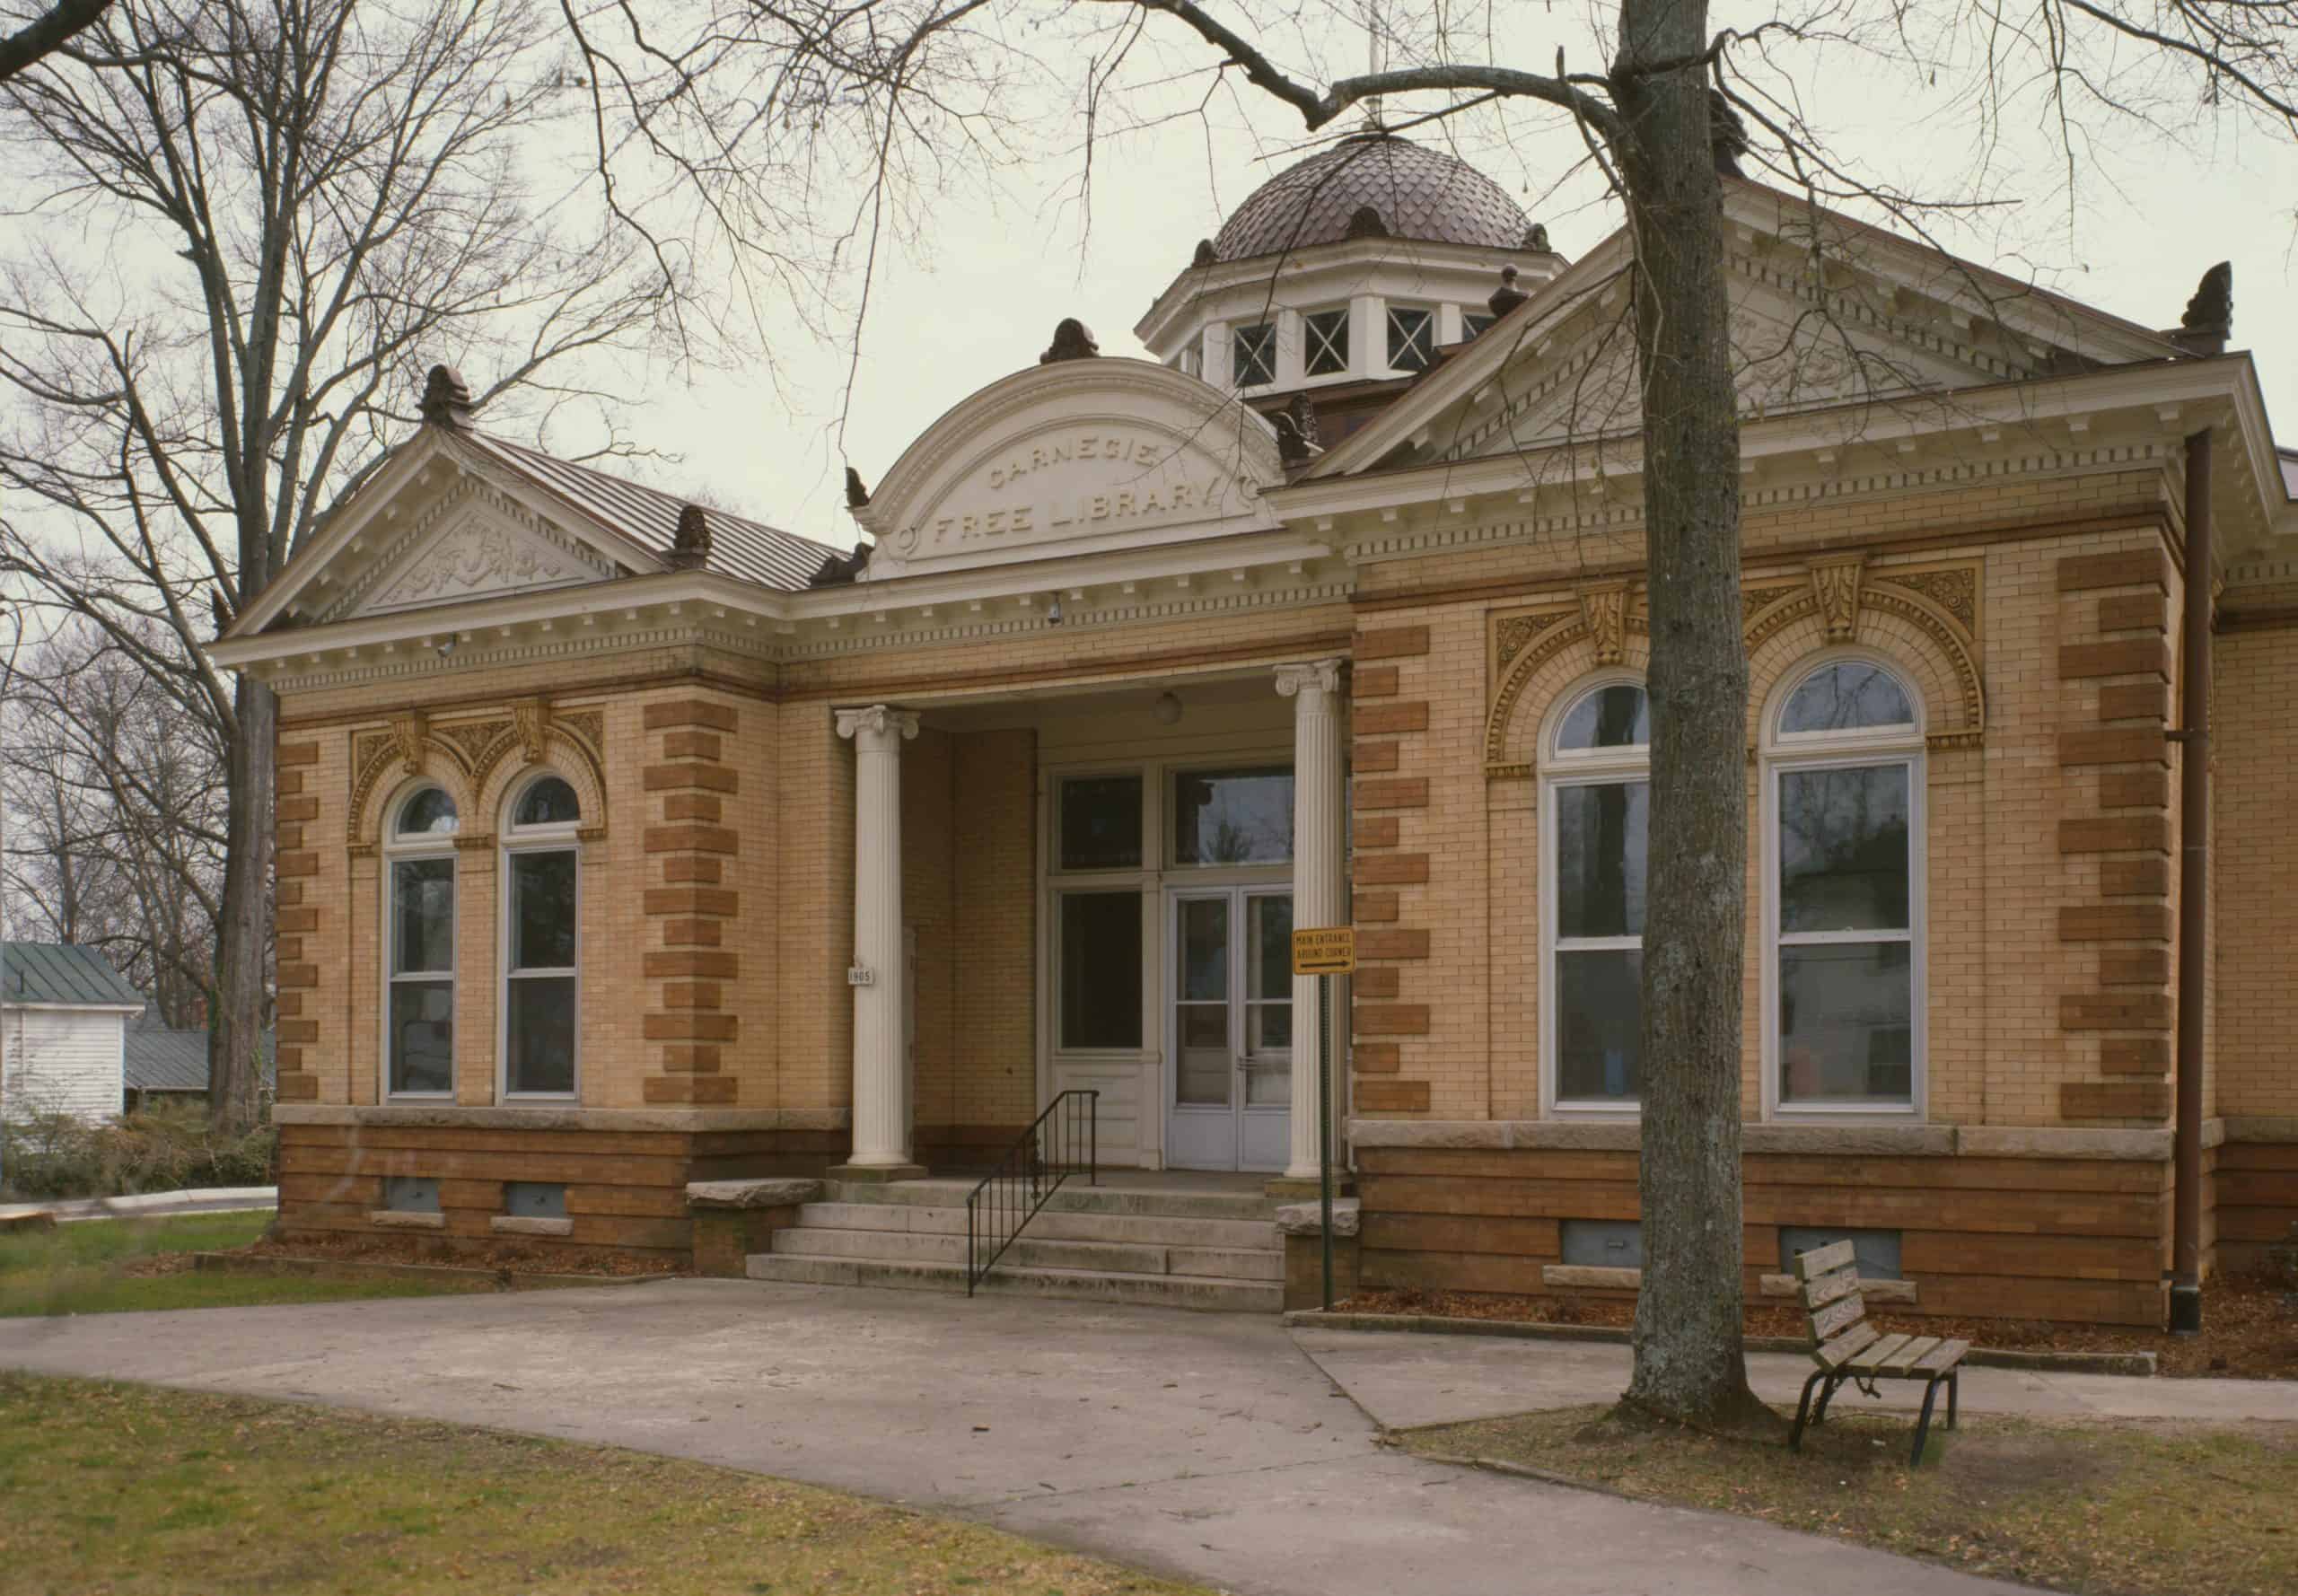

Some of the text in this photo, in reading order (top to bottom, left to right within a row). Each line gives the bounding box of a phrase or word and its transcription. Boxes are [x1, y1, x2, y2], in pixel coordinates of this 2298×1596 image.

[989, 435, 1162, 490] CARNEGIE
[934, 476, 1221, 544] FREE LIBRARY
[1296, 947, 1352, 960] AROUND CORNER
[1316, 933, 1351, 944] ENTRANCE
